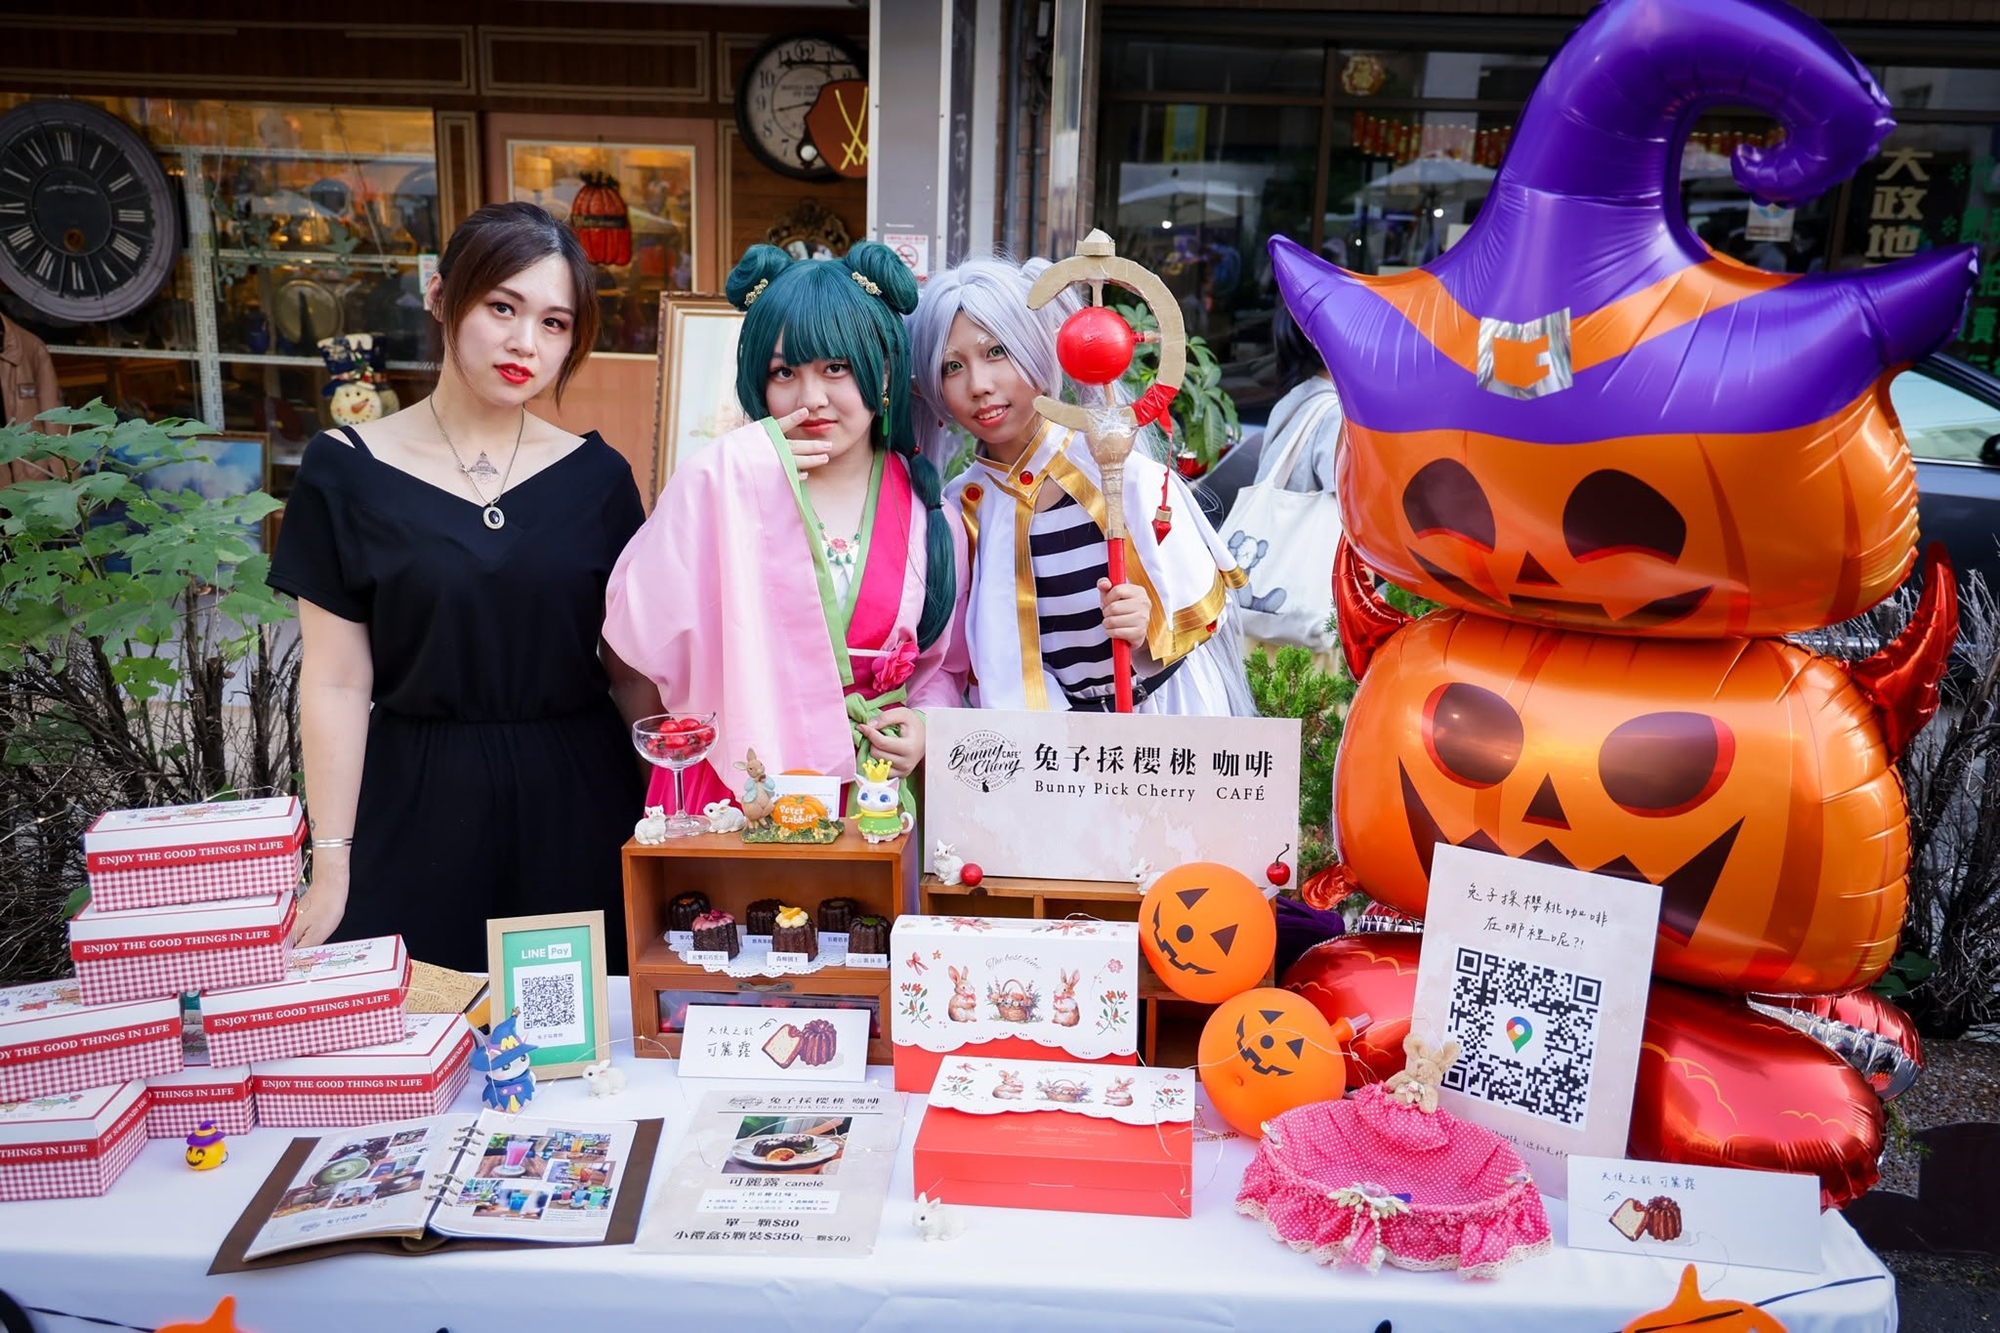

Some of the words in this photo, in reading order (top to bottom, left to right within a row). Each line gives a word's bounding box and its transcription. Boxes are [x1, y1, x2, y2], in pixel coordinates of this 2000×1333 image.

[1863, 148, 1933, 268] 大政地
[1033, 742, 1197, 777] 兔子採櫻桃
[1212, 749, 1274, 778] 咖啡
[1034, 780, 1085, 798] Bunny
[1094, 782, 1129, 796] Pick
[1137, 783, 1196, 802] Cherry
[1216, 785, 1266, 802] CAFÉ
[779, 804, 805, 815] Peter
[98, 854, 135, 866] ENJOY
[137, 852, 161, 862] THE
[164, 849, 196, 860] GOOD
[199, 845, 241, 857] THINGS
[244, 843, 257, 852] IN
[259, 841, 284, 851] LIFE
[82, 943, 120, 955] ENJOY
[122, 940, 147, 951] THE
[149, 937, 182, 949] GOOD
[184, 934, 228, 946] THINGS
[229, 932, 243, 941] IN
[245, 930, 271, 940] LIFE
[521, 948, 547, 960] LINE
[550, 947, 569, 956] Pay
[213, 1015, 248, 1027] ENJOY
[250, 1012, 274, 1022] THE
[276, 1007, 307, 1018] GOOD
[309, 1001, 350, 1013] THINGS
[352, 998, 365, 1007] IN
[367, 994, 391, 1005] LIFE
[15, 1046, 41, 1058] THE
[43, 1040, 78, 1053] GOOD
[81, 1032, 126, 1046] THINGS
[128, 1028, 142, 1039] IN
[144, 1023, 170, 1036] LIFE
[154, 1089, 194, 1099] THINGS
[195, 1088, 209, 1098] IN
[211, 1087, 235, 1097] LIFE
[262, 1079, 292, 1089] ENJOY
[293, 1080, 313, 1088] THE
[316, 1079, 344, 1088] GOOD
[347, 1079, 384, 1088] THINGS
[386, 1079, 397, 1087] IN
[400, 1078, 423, 1087] LIFE
[44, 1145, 59, 1156] IN
[61, 1144, 88, 1155] LIFE
[729, 1177, 779, 1187] 可麗露
